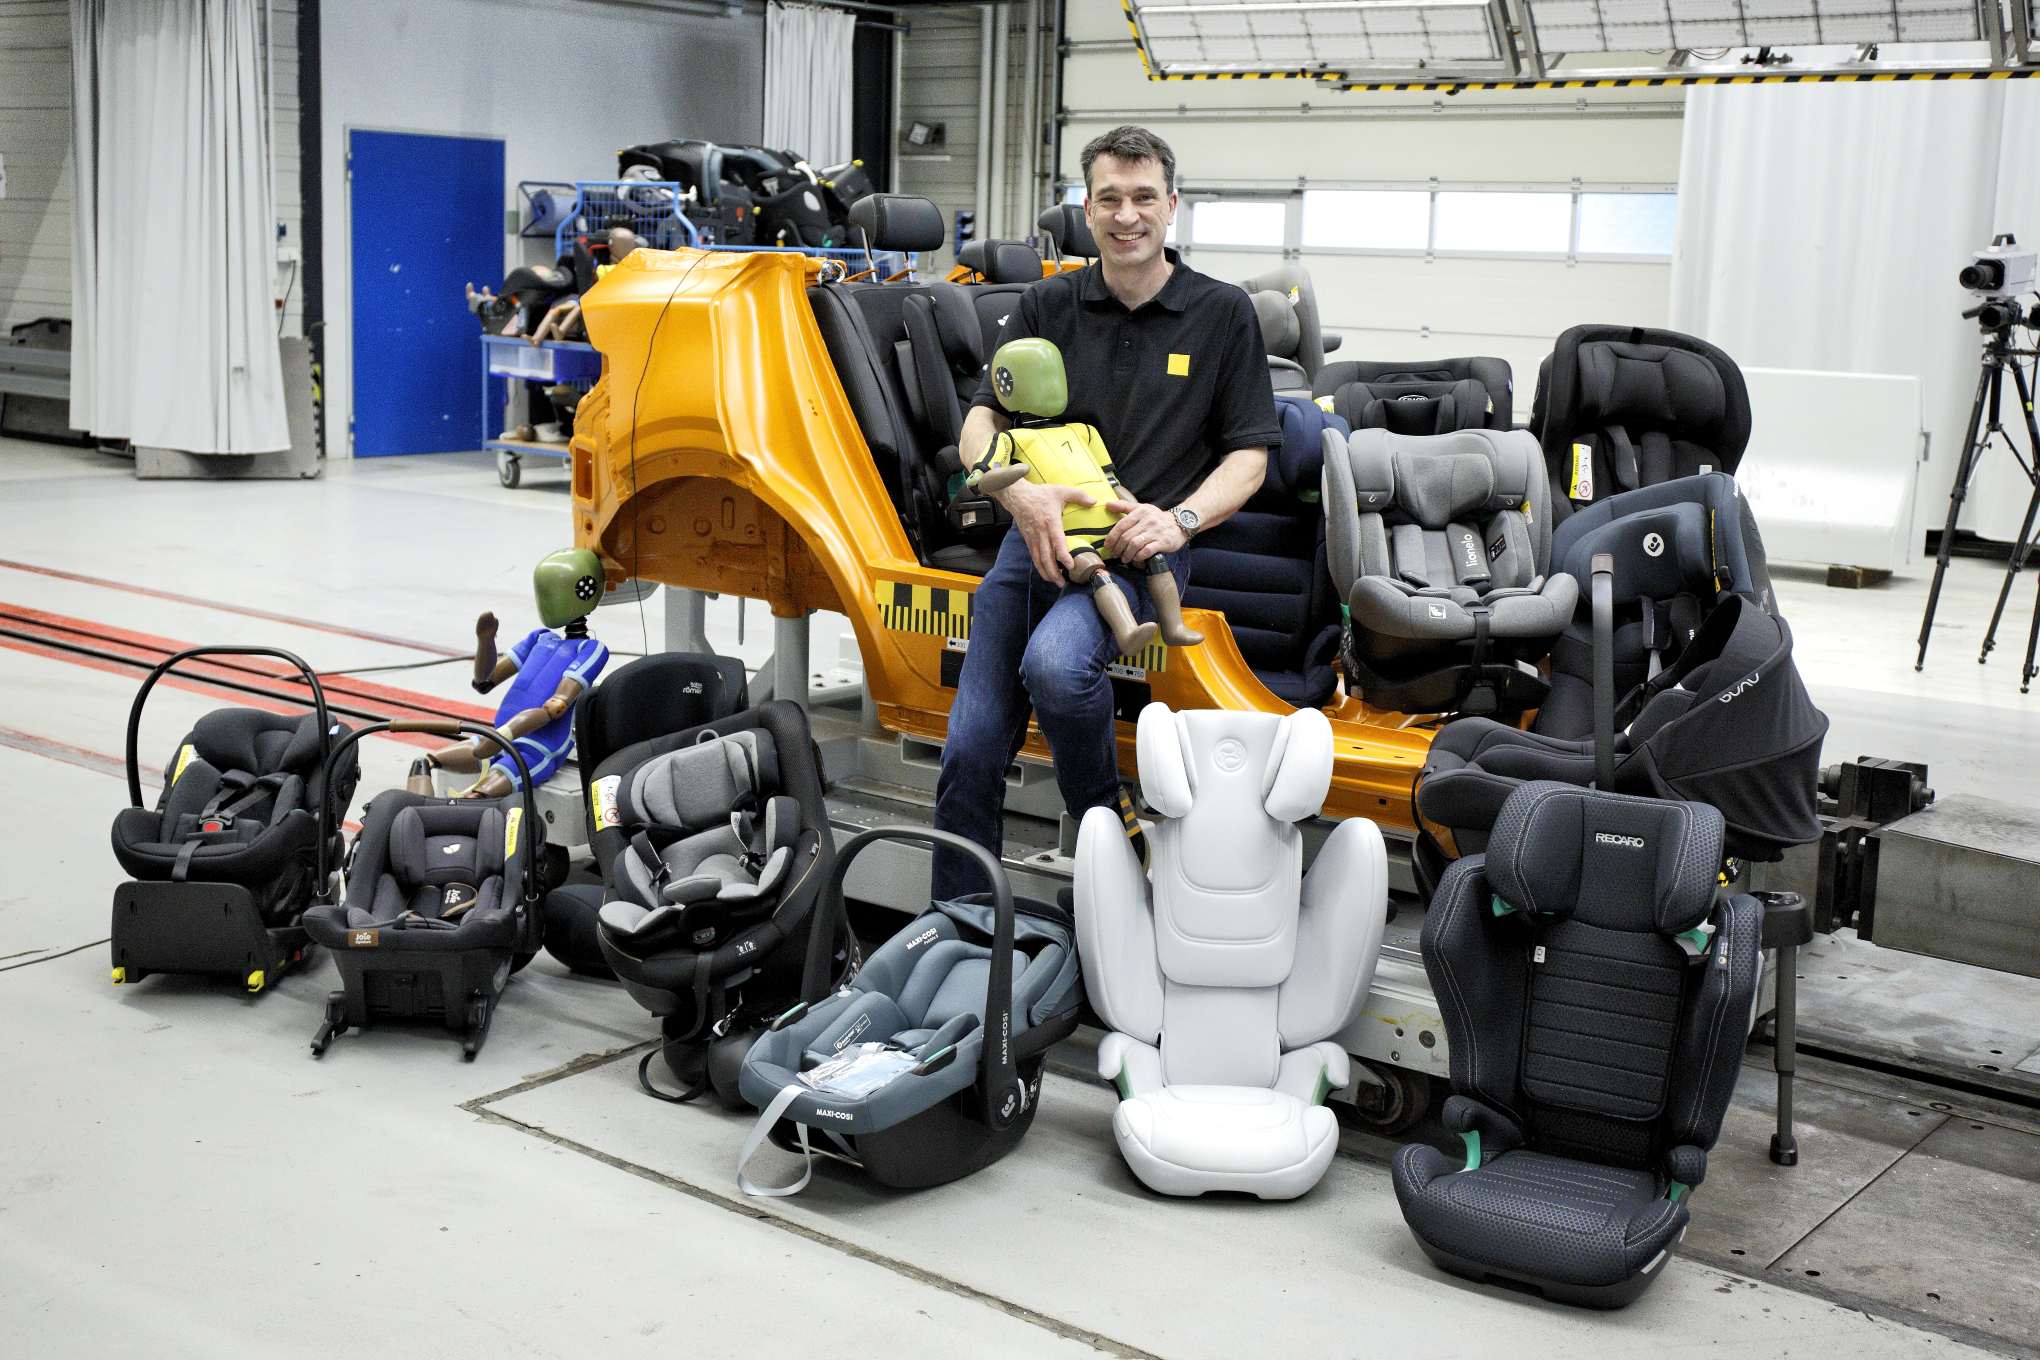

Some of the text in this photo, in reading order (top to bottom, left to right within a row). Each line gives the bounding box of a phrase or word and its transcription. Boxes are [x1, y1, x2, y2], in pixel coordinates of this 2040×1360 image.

[1461, 533, 1479, 568] lionelo
[1595, 832, 1644, 847] RECARO
[906, 927, 937, 950] MAXI-COSI
[1001, 1012, 1009, 1065] MAXI-COSI
[815, 1108, 854, 1120] MAXI-COSI
